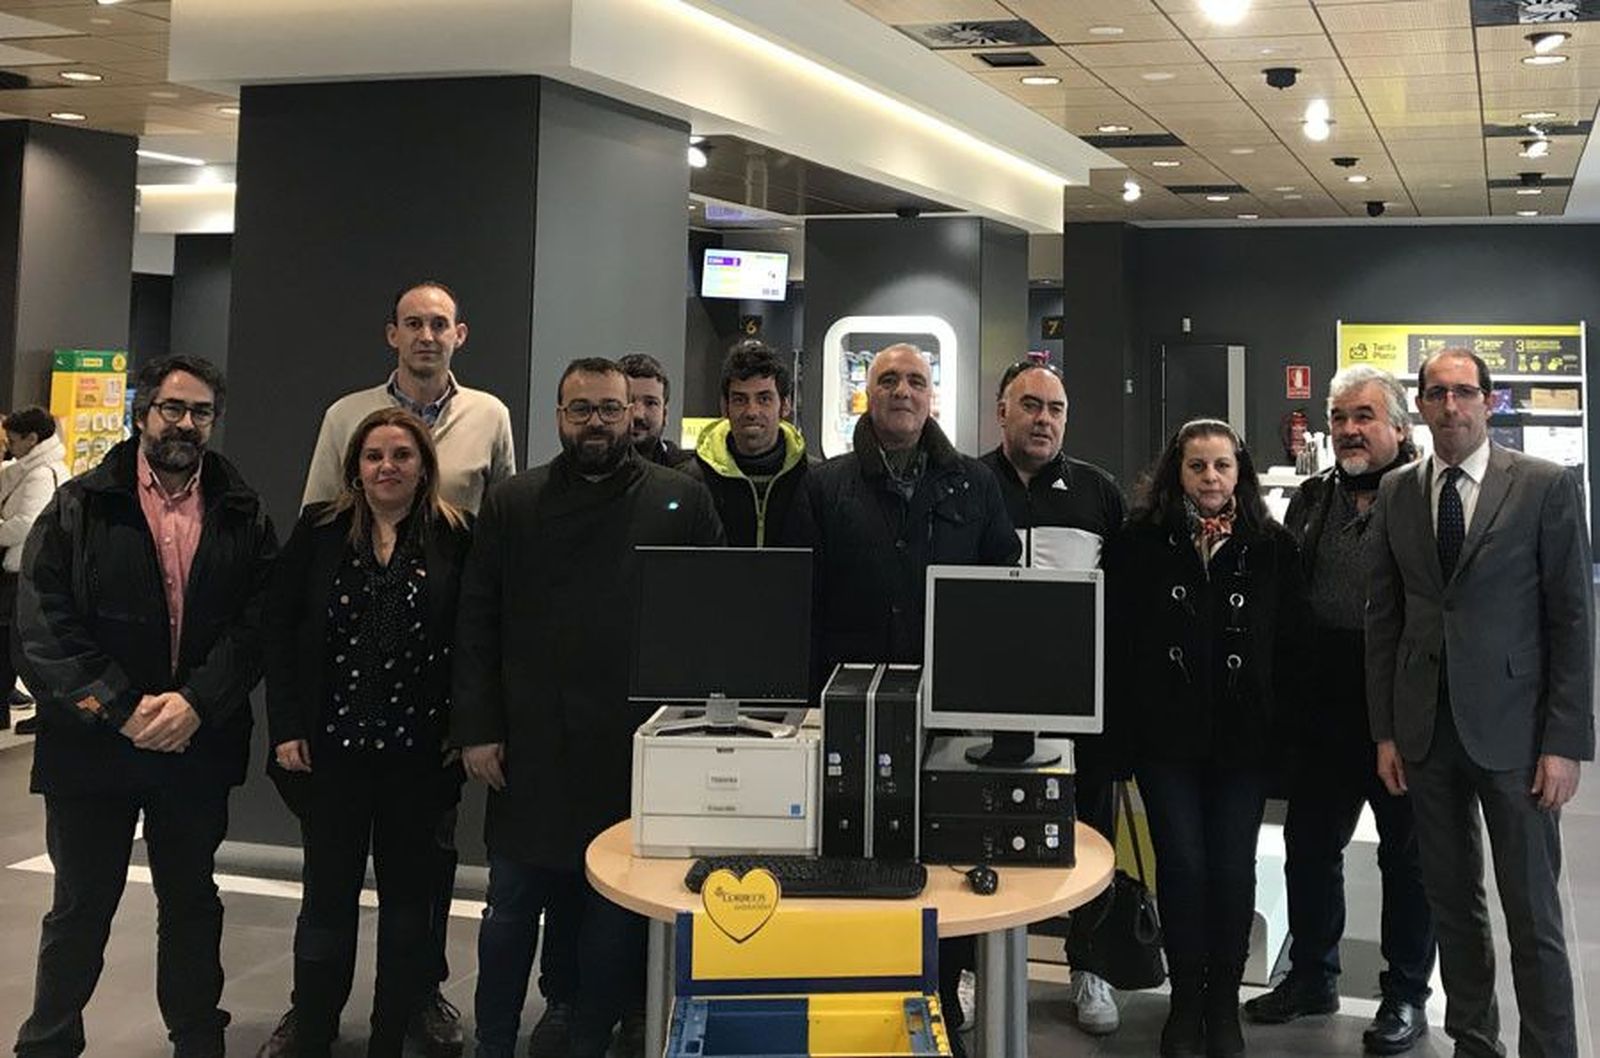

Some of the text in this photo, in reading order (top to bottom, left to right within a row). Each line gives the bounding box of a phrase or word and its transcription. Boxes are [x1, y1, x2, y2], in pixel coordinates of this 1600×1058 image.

[745, 320, 757, 335] 6
[1048, 320, 1058, 335] 7
[1516, 339, 1525, 352] 3
